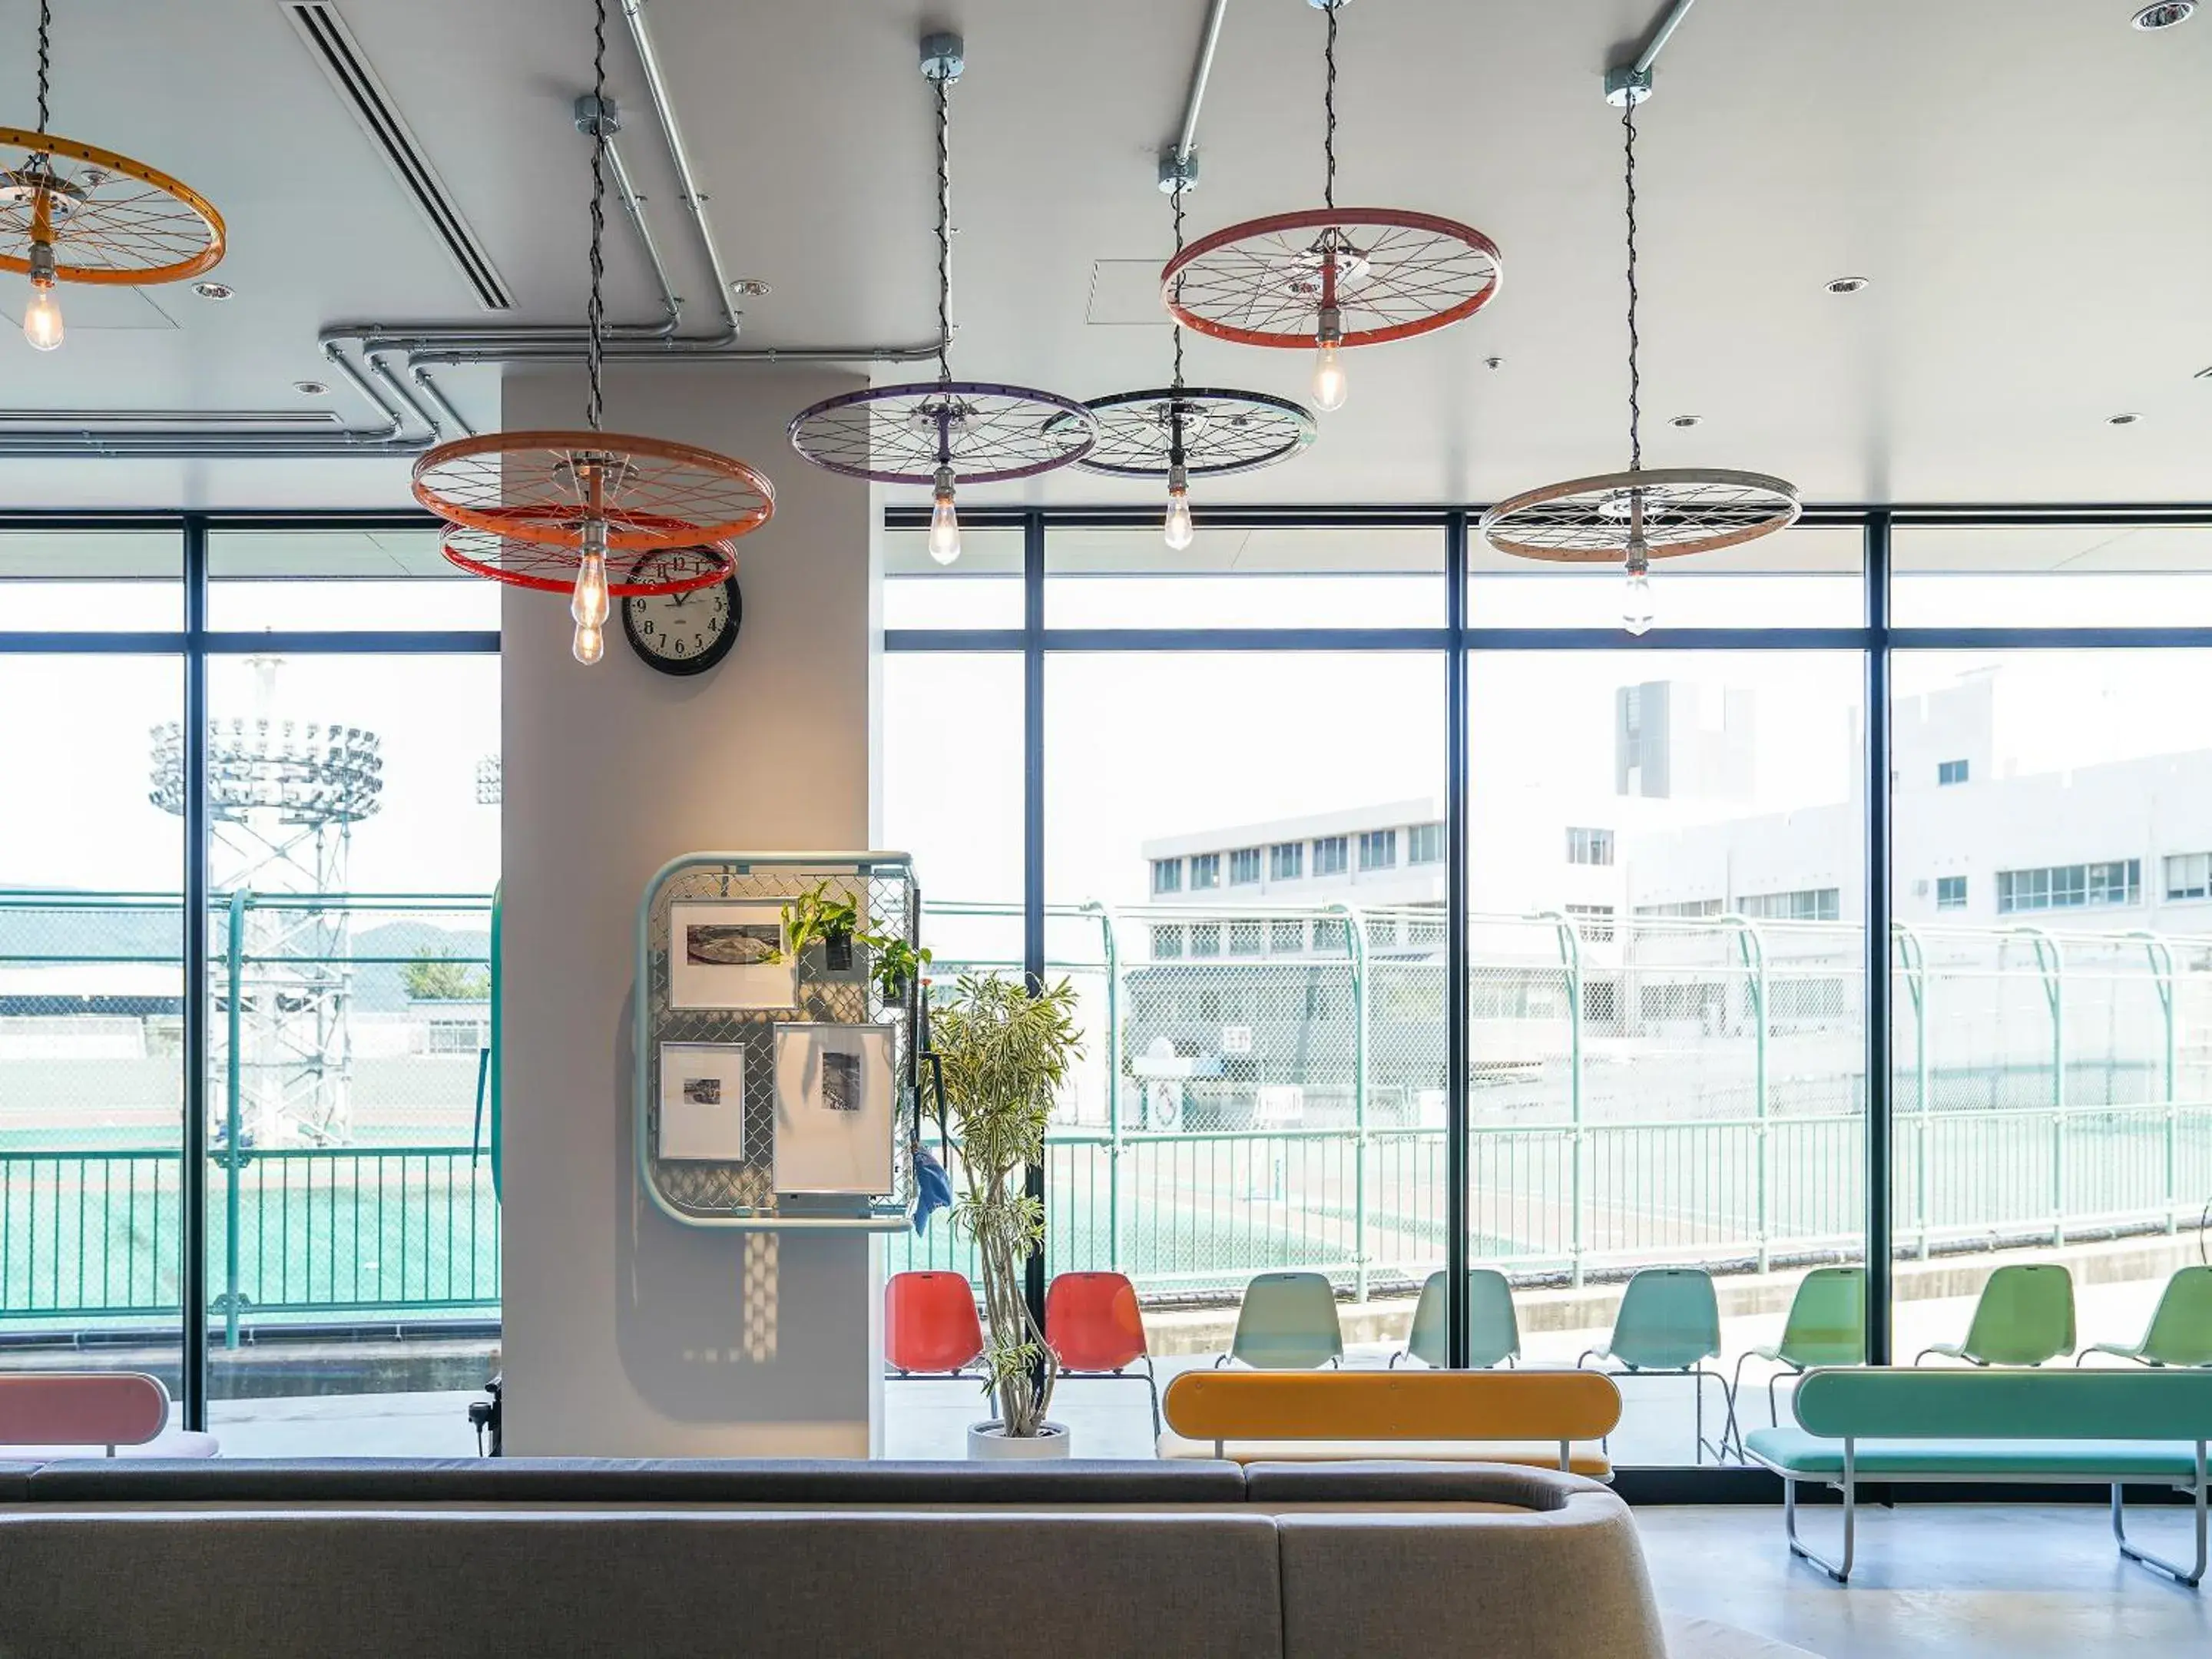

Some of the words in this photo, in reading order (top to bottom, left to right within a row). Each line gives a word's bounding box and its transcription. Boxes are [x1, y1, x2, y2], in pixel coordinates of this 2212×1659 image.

[637, 598, 647, 613] 9
[714, 597, 723, 612] 3
[644, 620, 654, 634] 8
[707, 618, 717, 631] 4
[659, 634, 667, 647] 7
[675, 639, 684, 653] 6
[695, 634, 703, 648] 5
